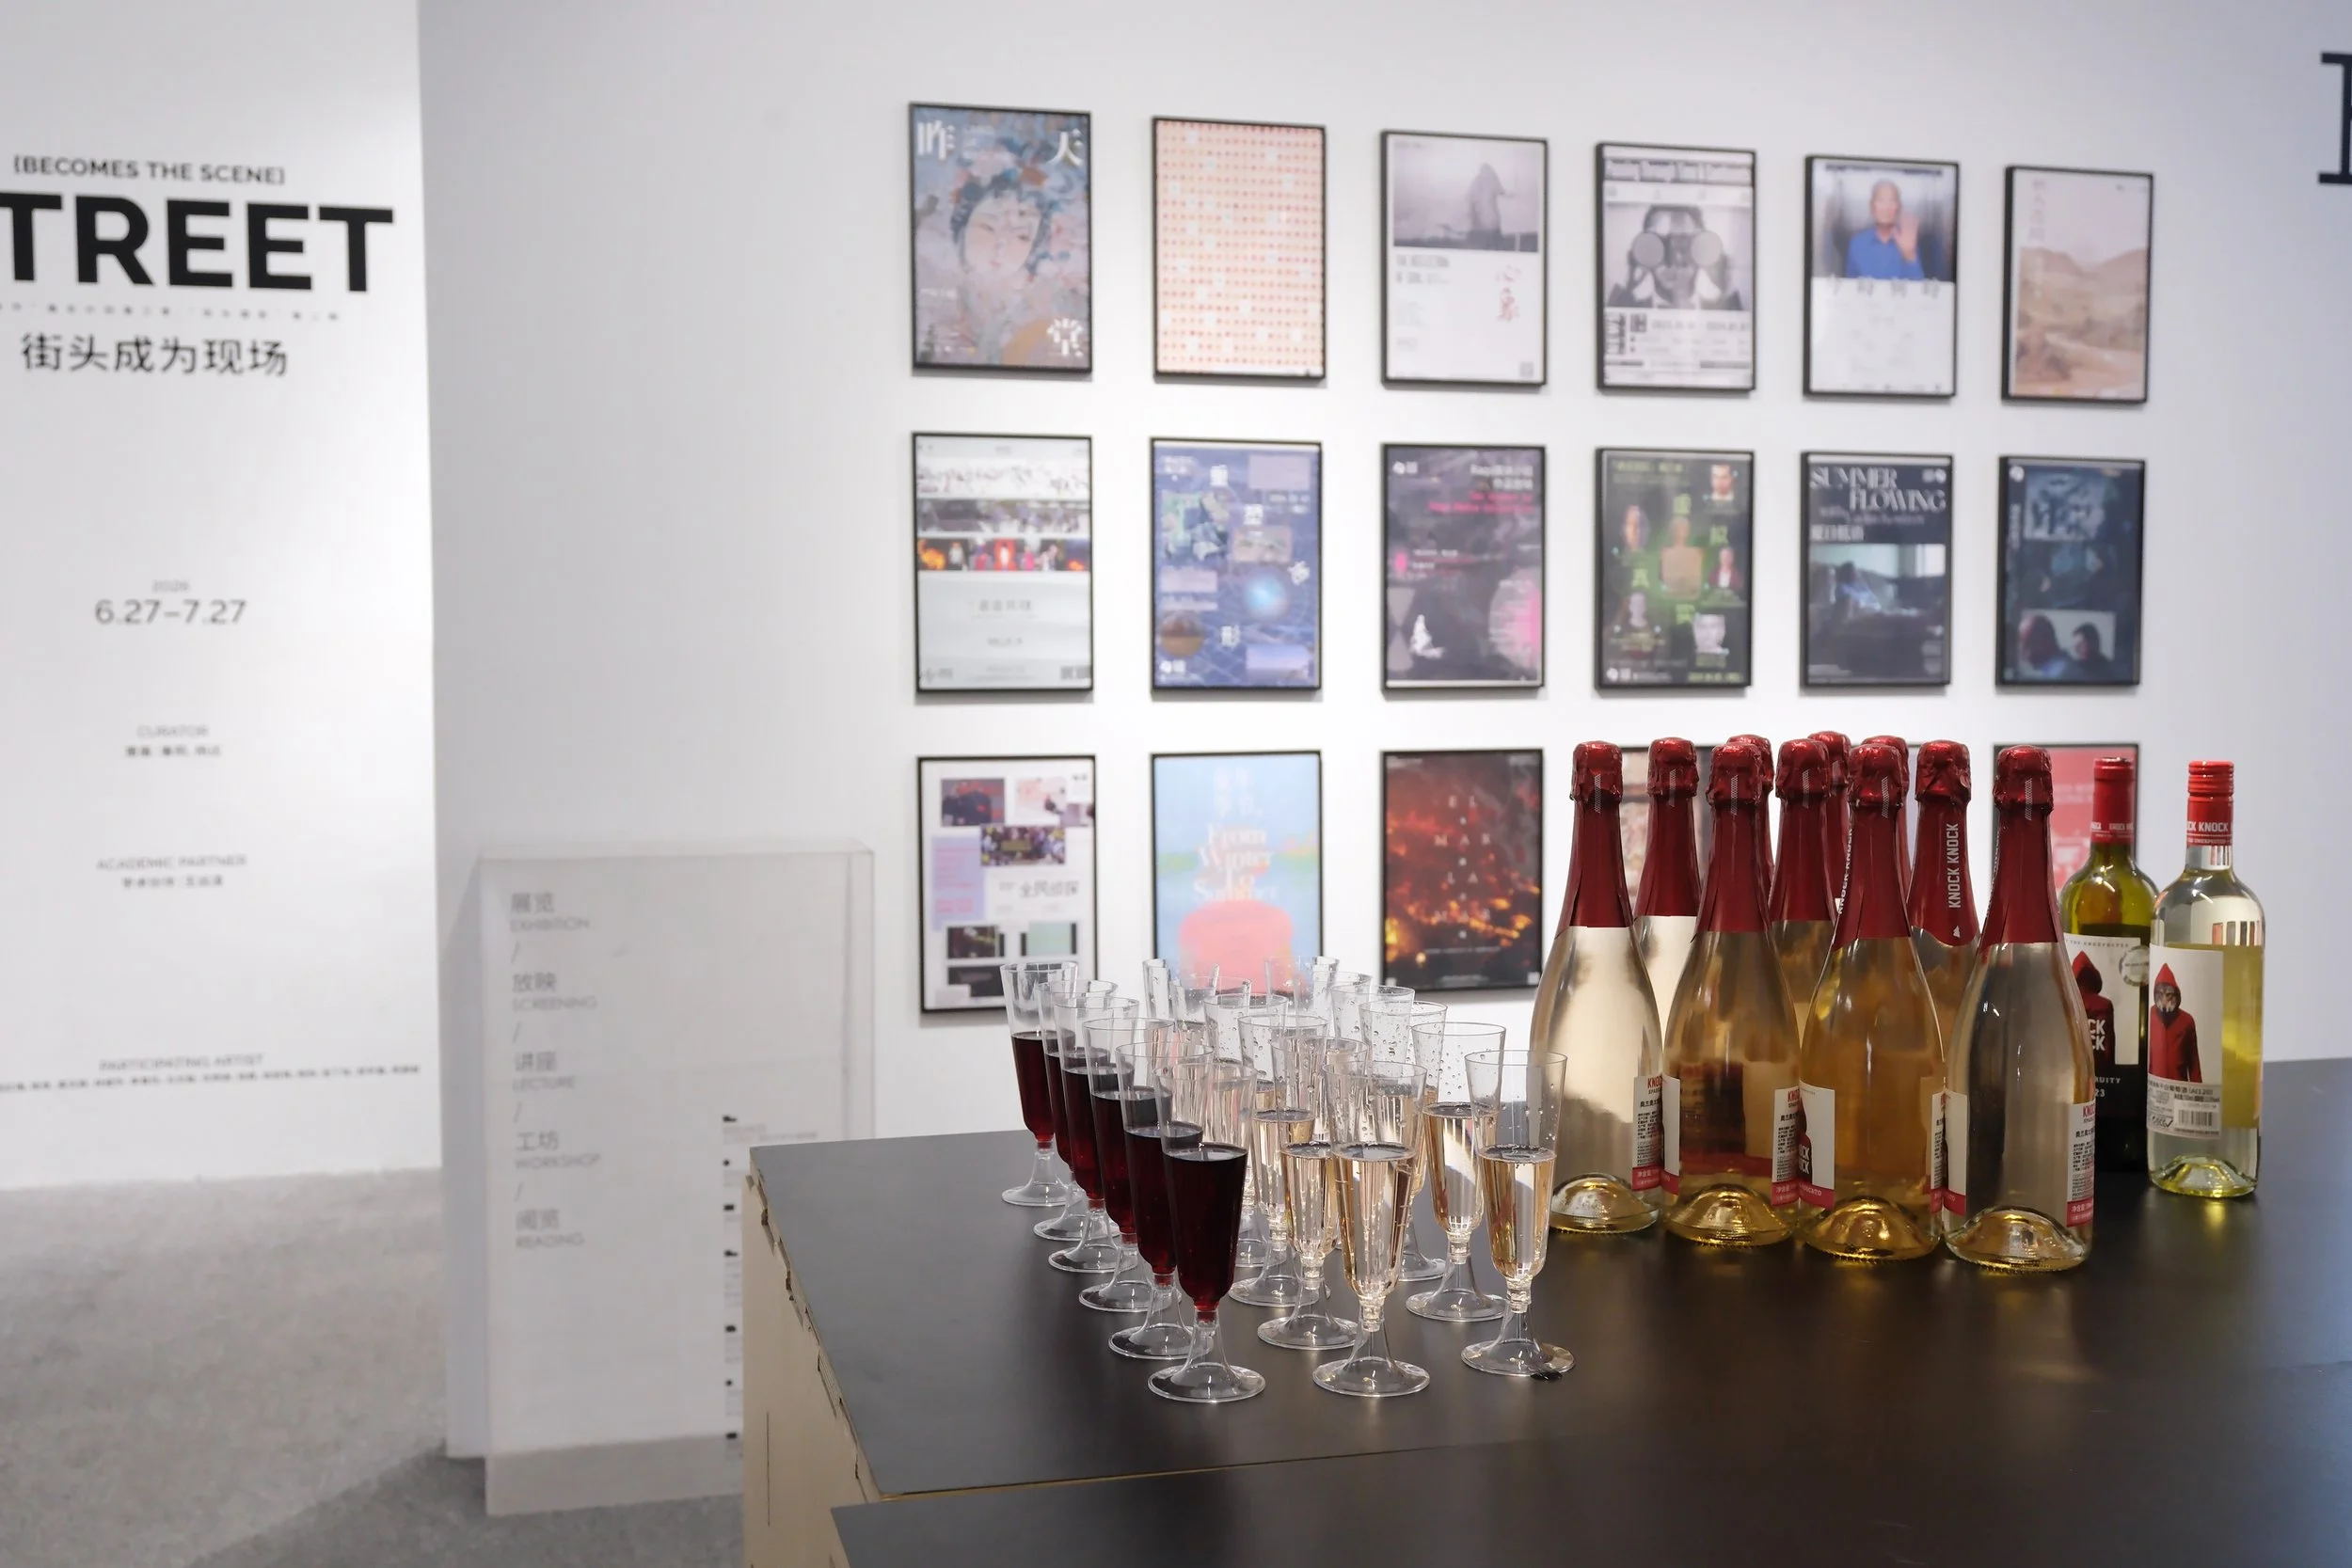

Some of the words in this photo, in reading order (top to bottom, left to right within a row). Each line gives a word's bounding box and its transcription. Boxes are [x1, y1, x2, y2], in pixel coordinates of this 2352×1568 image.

[147, 161, 192, 182] THE
[22, 332, 287, 375] 街头成为现场
[1849, 488, 1947, 513] FLOWING
[136, 725, 209, 739] CURATOR
[2198, 821, 2229, 832] KNOCK
[1946, 823, 1959, 863] KNOCK
[96, 857, 173, 871] ACADEMIC
[178, 854, 247, 868] PARTNER
[1947, 867, 1962, 909] KNOCK
[511, 892, 555, 914] 展览
[510, 916, 590, 933] EXHIBITION
[513, 971, 558, 993] 放映
[513, 995, 598, 1013] SCREENING
[515, 1051, 557, 1072] 讲座
[513, 1075, 576, 1093] LECTURE
[516, 1130, 560, 1152] 工坊
[515, 1152, 601, 1170] WORKSHOP
[516, 1232, 585, 1250] READING
